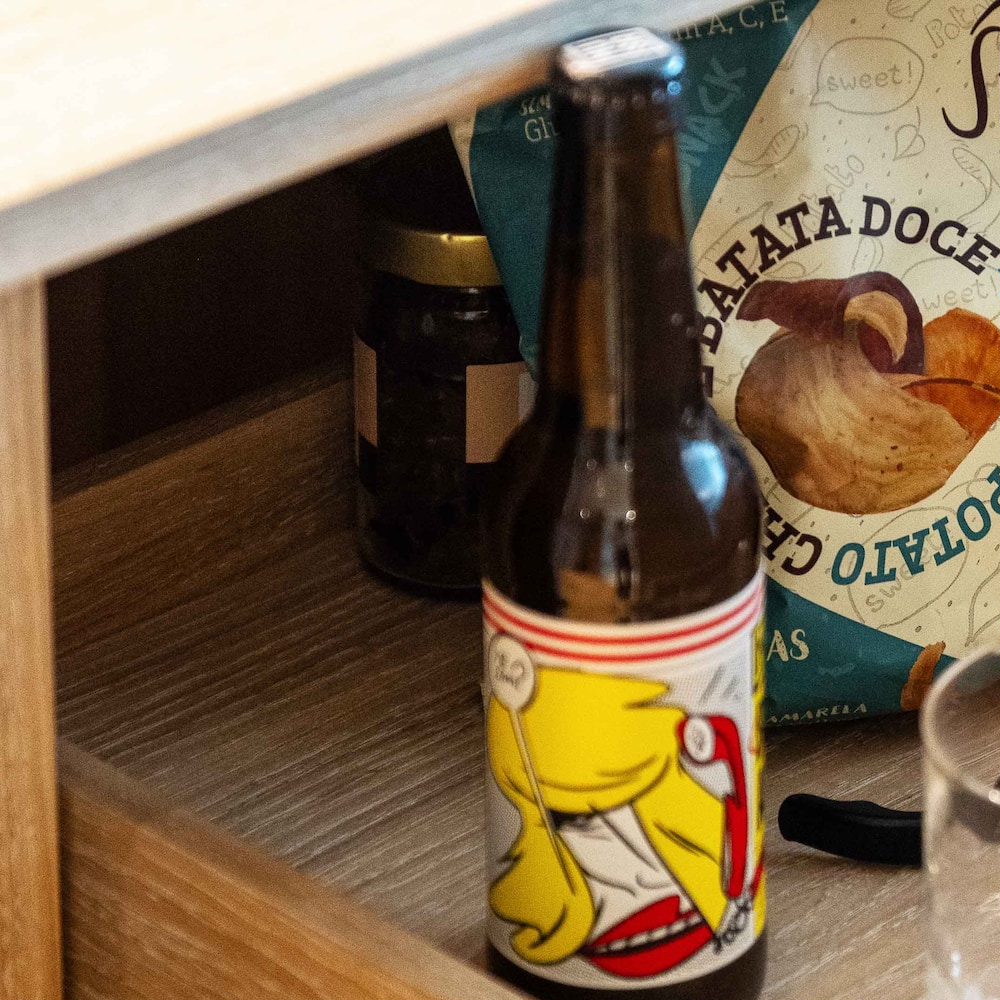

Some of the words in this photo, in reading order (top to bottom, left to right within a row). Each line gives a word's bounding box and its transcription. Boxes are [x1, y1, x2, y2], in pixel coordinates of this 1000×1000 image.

[739, 5, 764, 29] C,
[769, 1, 789, 23] E
[827, 61, 914, 92] sweet!
[697, 194, 852, 355] BATATA
[858, 194, 1000, 276] DOCE
